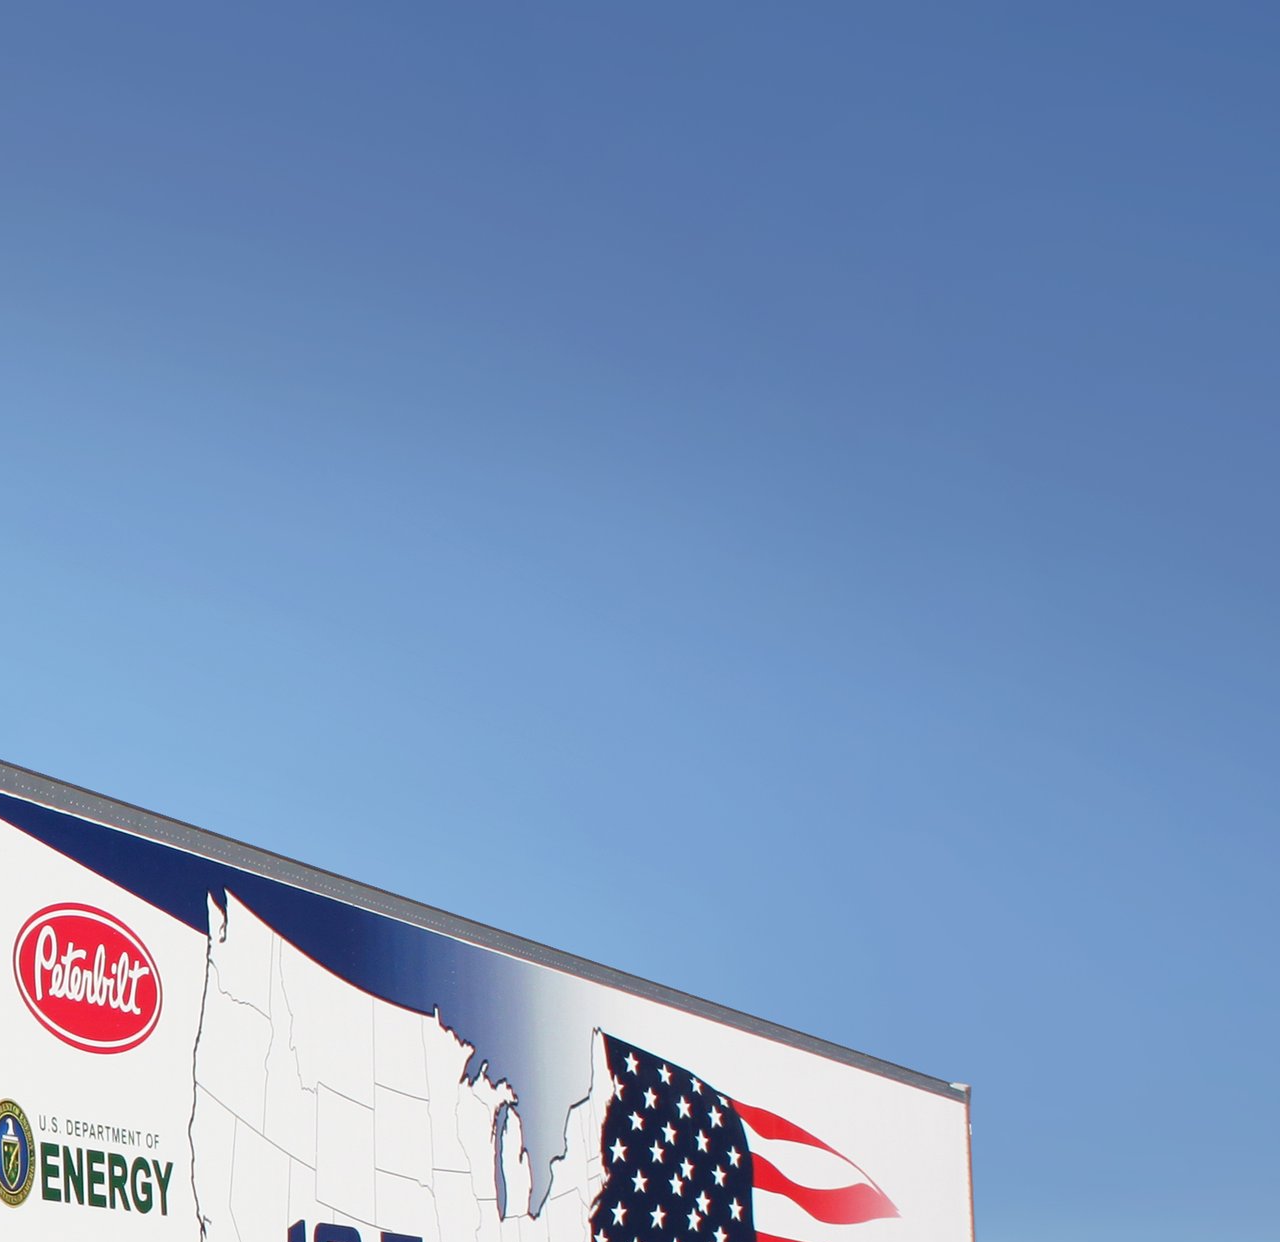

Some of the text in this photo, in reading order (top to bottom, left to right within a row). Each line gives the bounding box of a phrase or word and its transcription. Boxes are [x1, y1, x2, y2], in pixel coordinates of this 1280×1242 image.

[34, 924, 150, 1016] Peterbilt
[38, 1114, 160, 1150] U.S. DEPARTMENT OF
[40, 1141, 174, 1216] ENERGY
